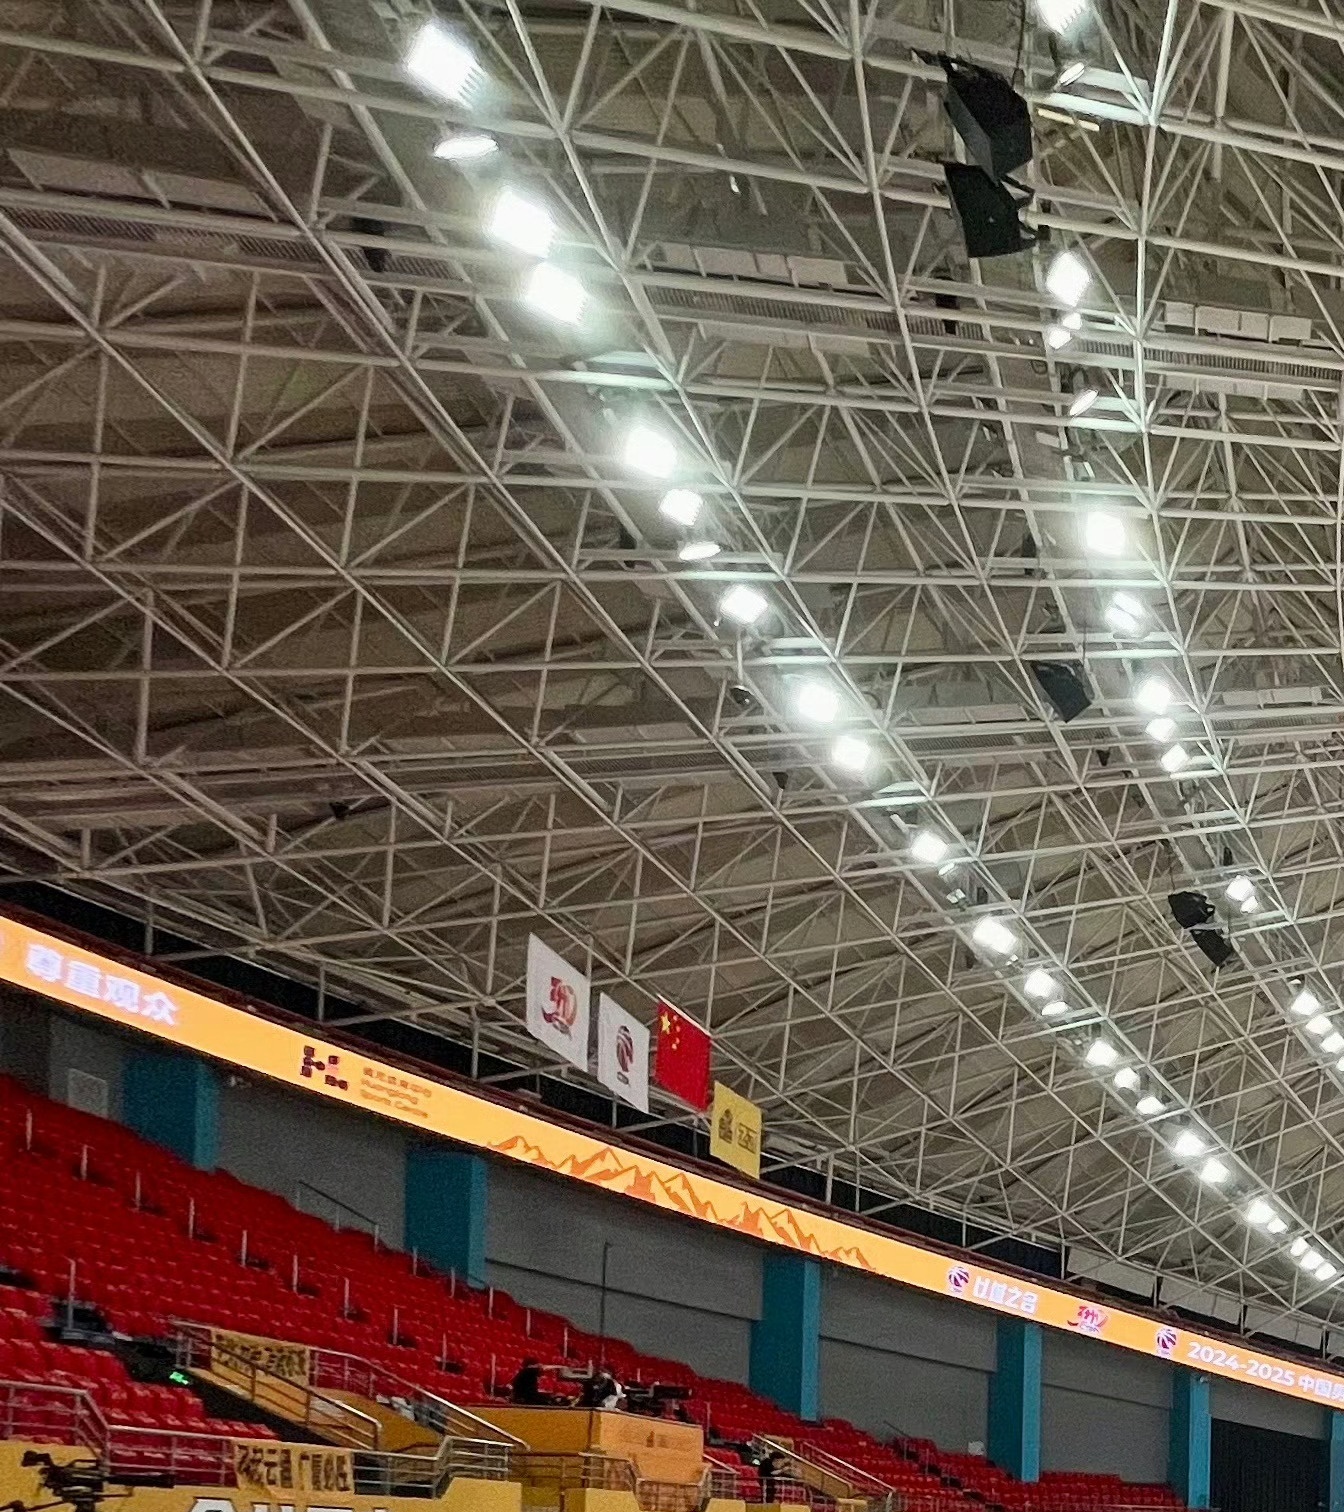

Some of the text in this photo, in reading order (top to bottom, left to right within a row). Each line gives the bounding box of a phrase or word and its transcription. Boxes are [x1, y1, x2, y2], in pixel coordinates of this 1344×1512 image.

[26, 942, 179, 1027] 尊重观众
[1187, 1341, 1296, 1387] 2024-2025
